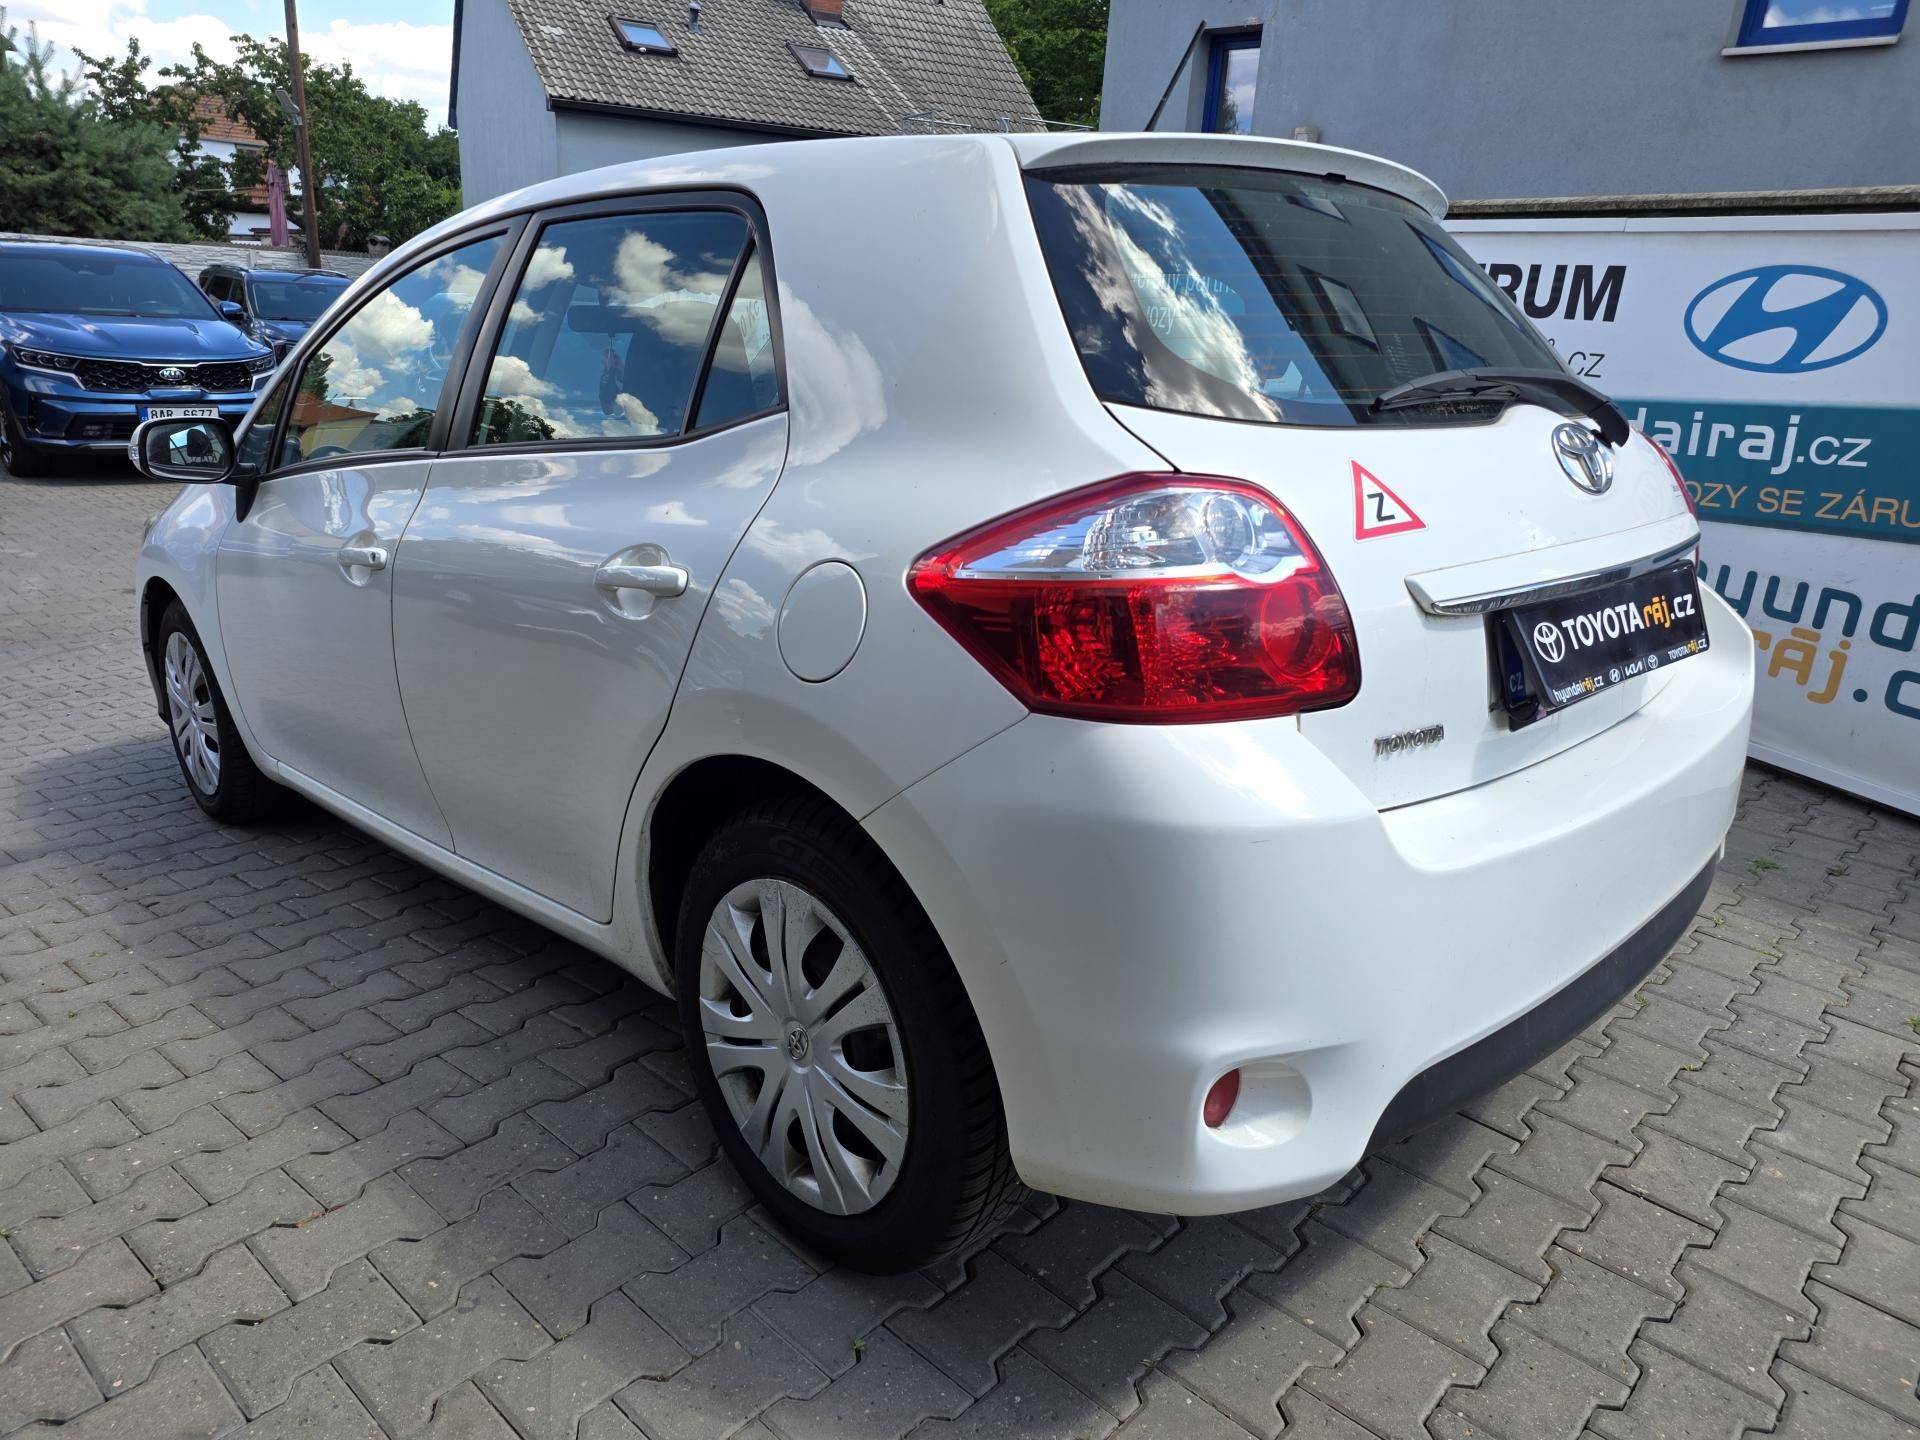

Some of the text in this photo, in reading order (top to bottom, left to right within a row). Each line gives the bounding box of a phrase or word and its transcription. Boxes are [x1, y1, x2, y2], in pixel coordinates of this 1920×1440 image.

[1478, 263, 1627, 322] RUM
[1366, 491, 1396, 522] Z
[1757, 487, 1805, 516] SE
[1373, 723, 1445, 757] TOYOTA
